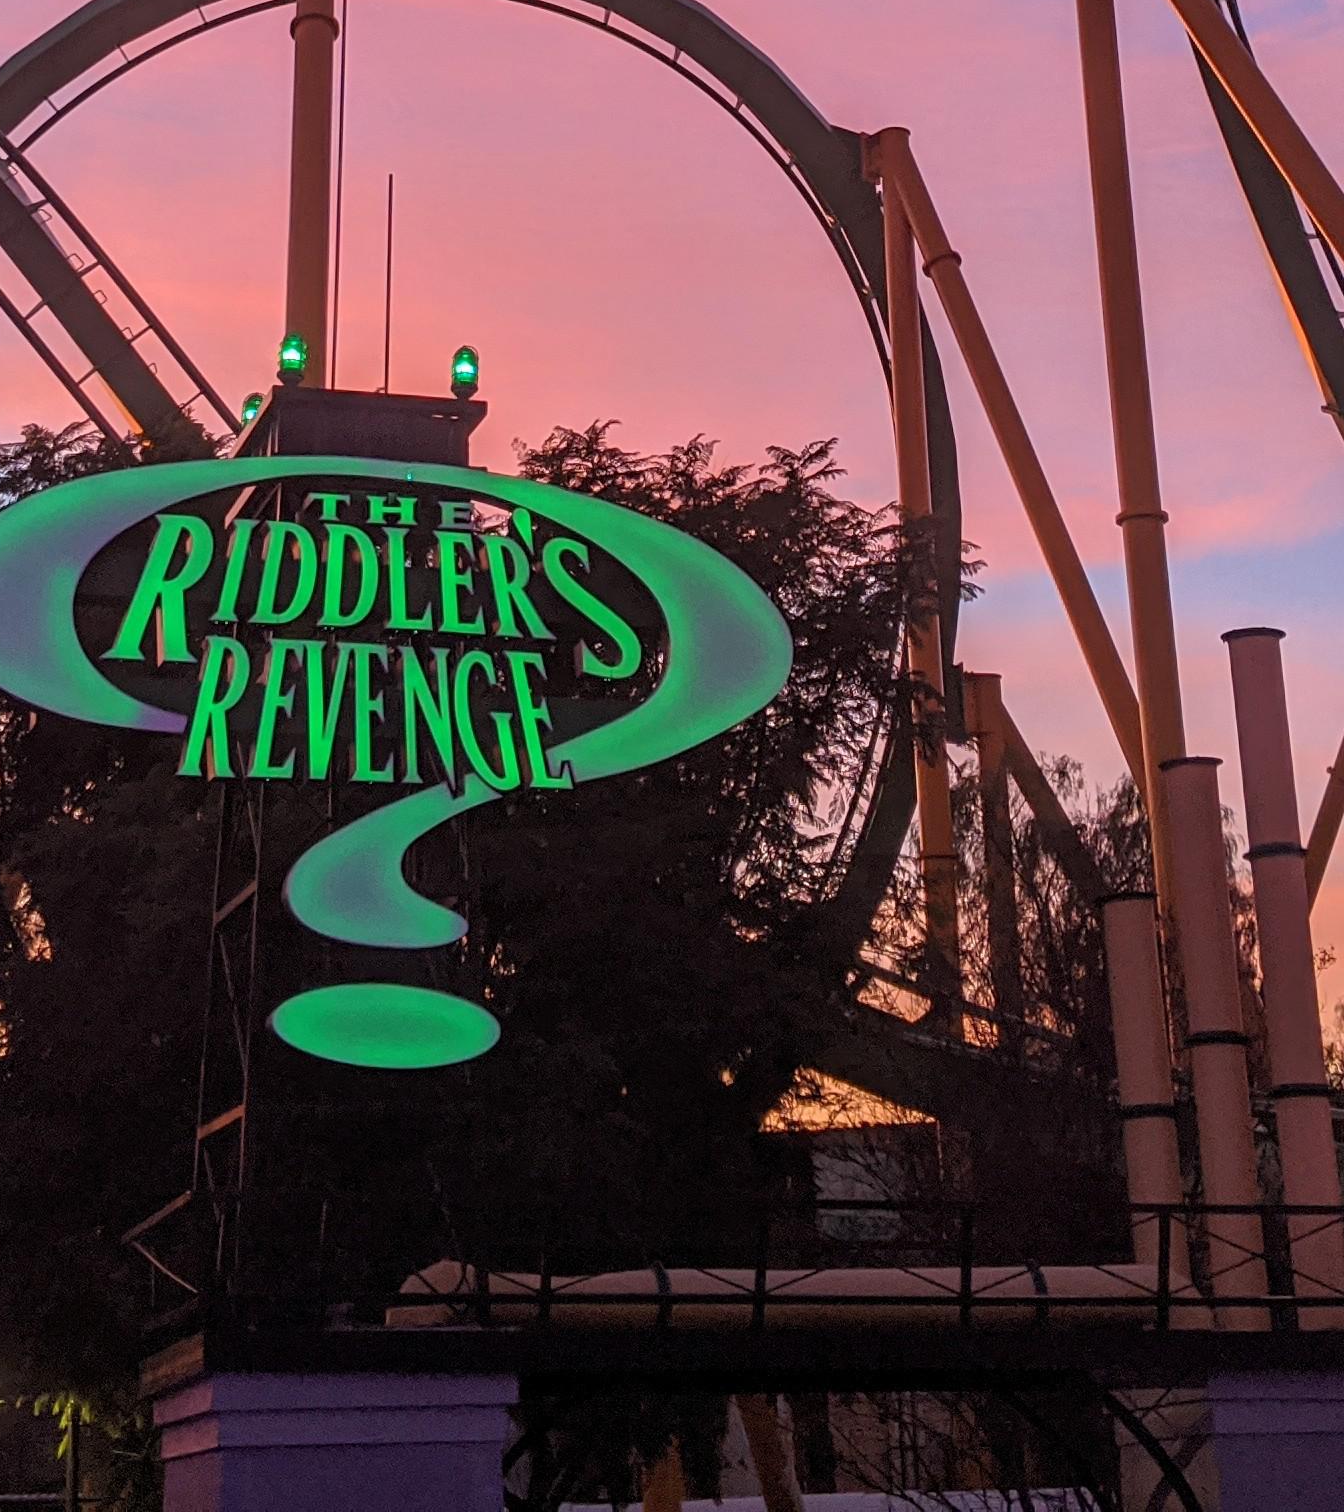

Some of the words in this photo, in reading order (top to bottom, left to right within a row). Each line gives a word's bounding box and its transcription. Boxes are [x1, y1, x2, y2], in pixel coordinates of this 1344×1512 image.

[310, 492, 471, 526] THE
[103, 508, 642, 679] RIDDLER'S
[177, 637, 575, 792] REVENGE
